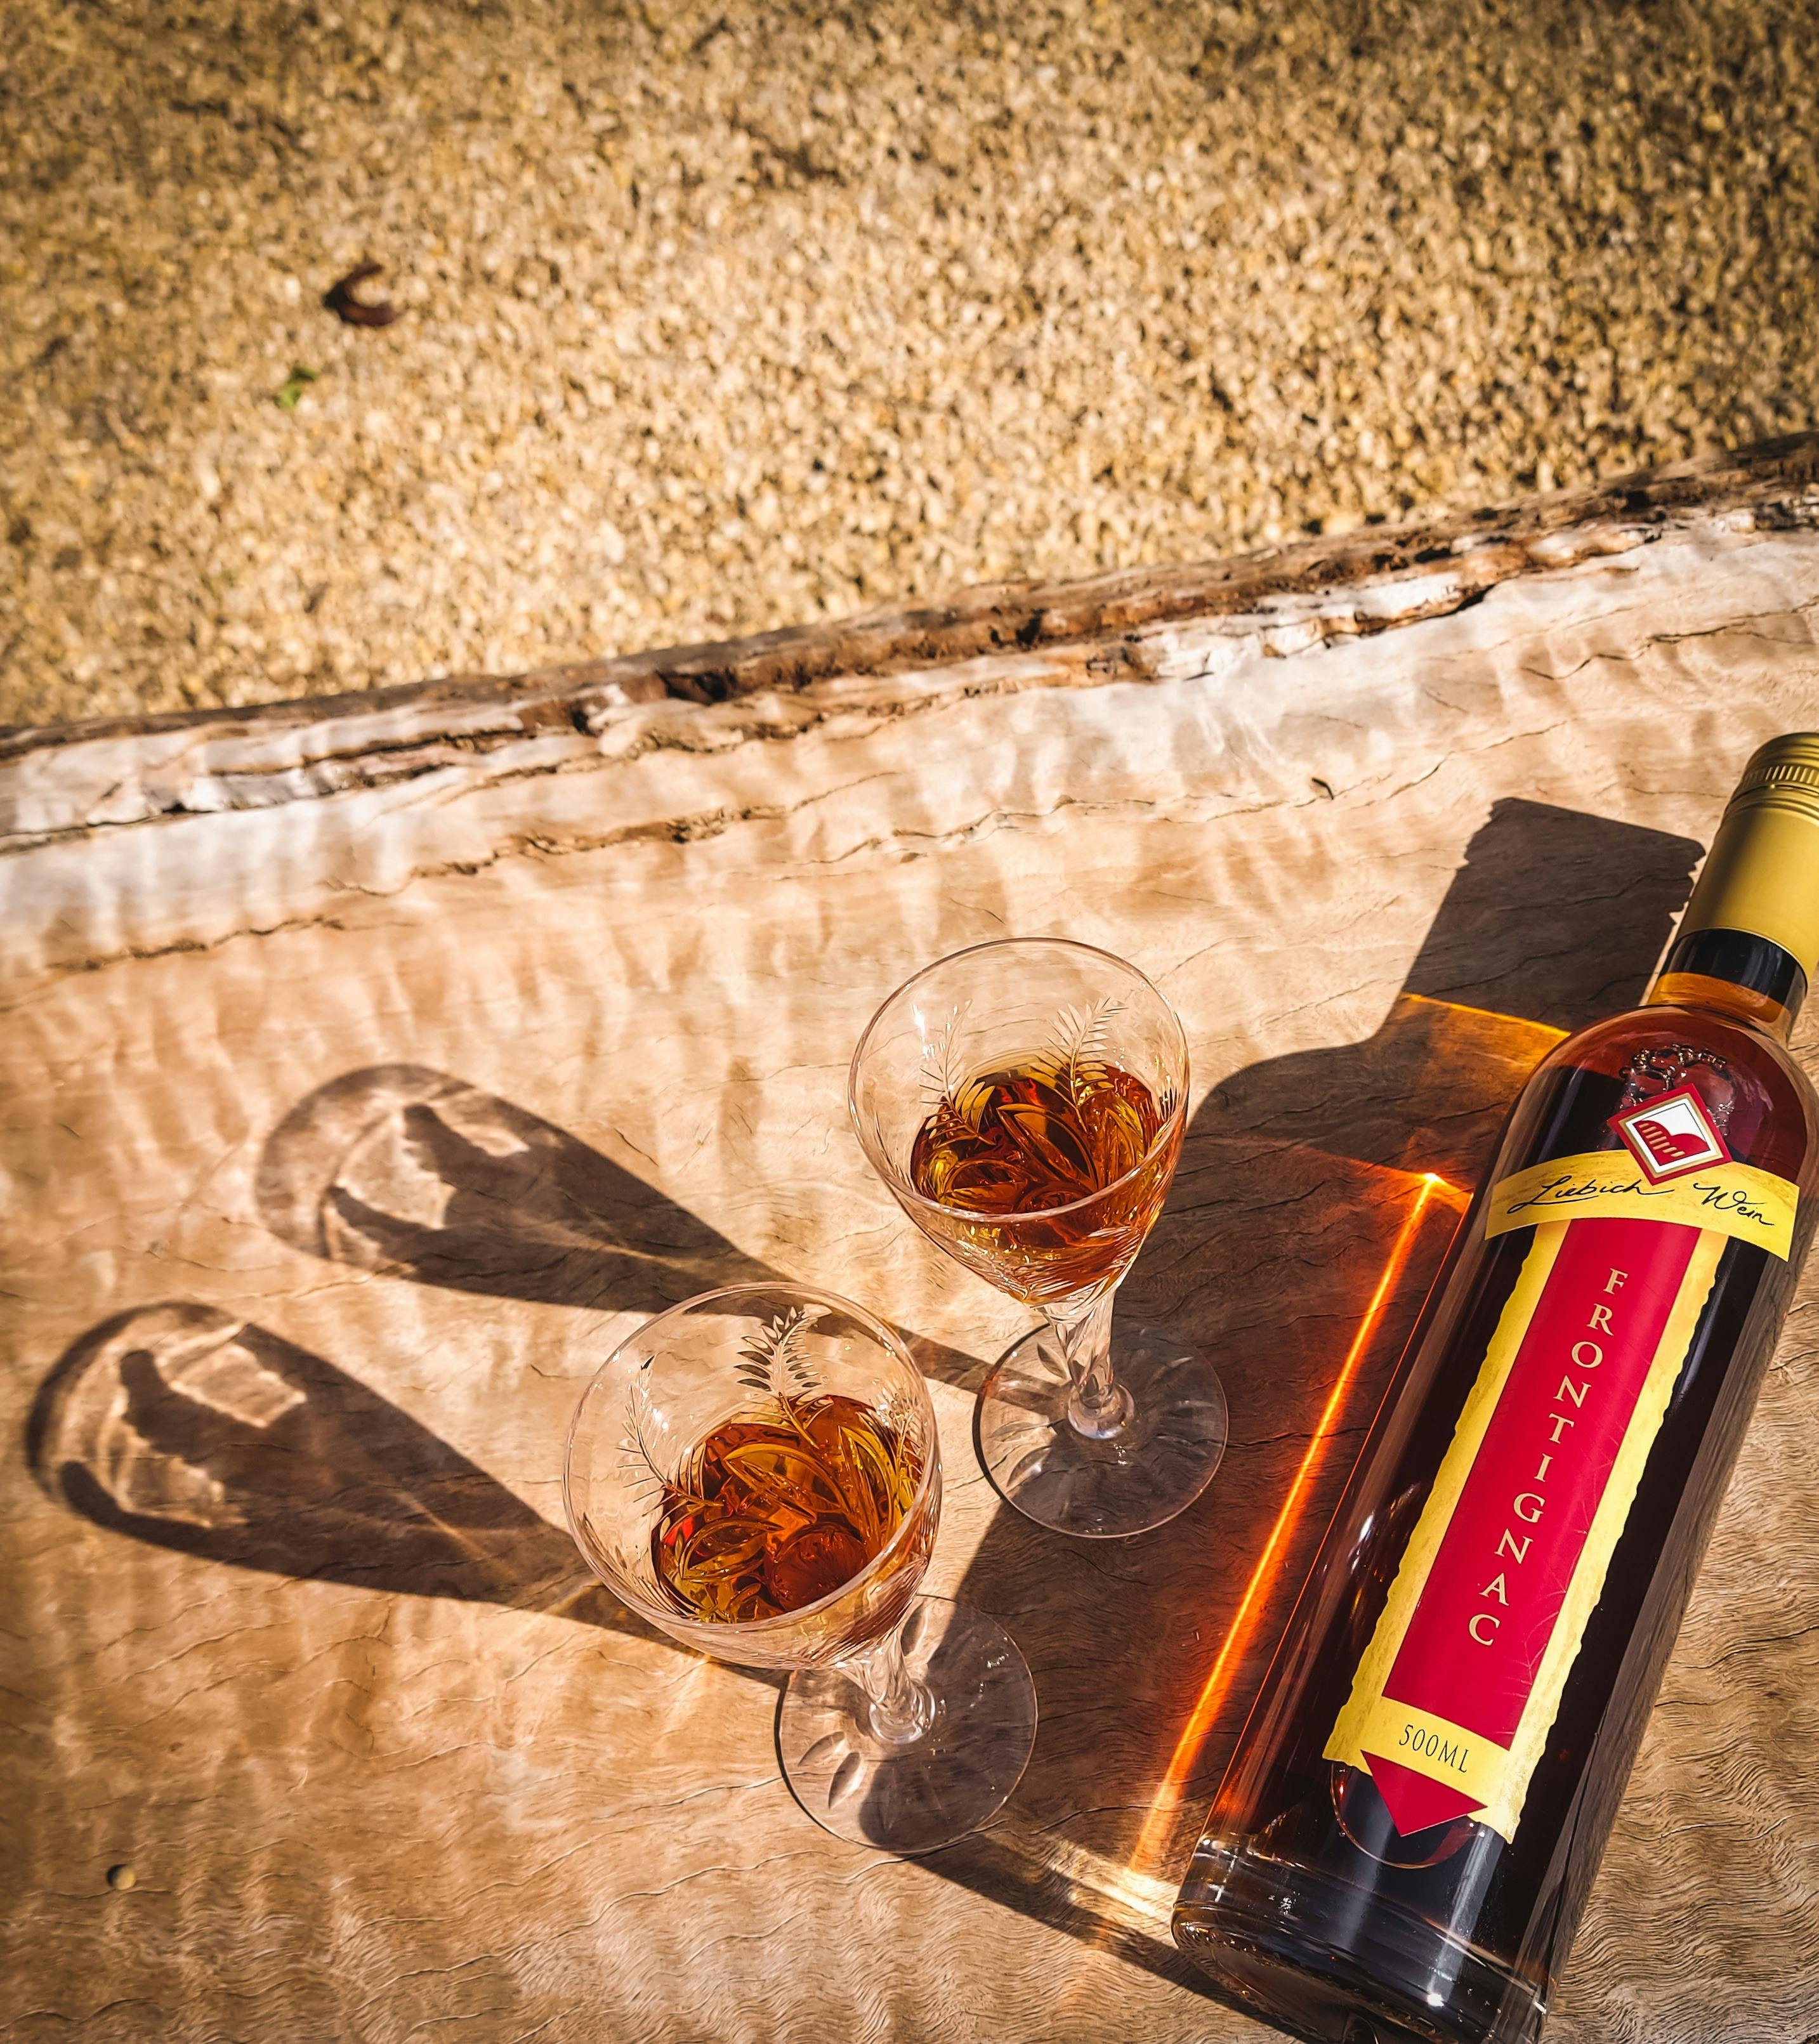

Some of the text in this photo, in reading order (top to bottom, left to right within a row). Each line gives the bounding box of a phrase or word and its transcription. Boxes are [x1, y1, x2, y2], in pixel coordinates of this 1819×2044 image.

[1506, 1175, 1775, 1226] Liebich Wein
[1468, 1268, 1628, 1646] FRONTIGNAC
[1399, 1724, 1469, 1773] 500ML
